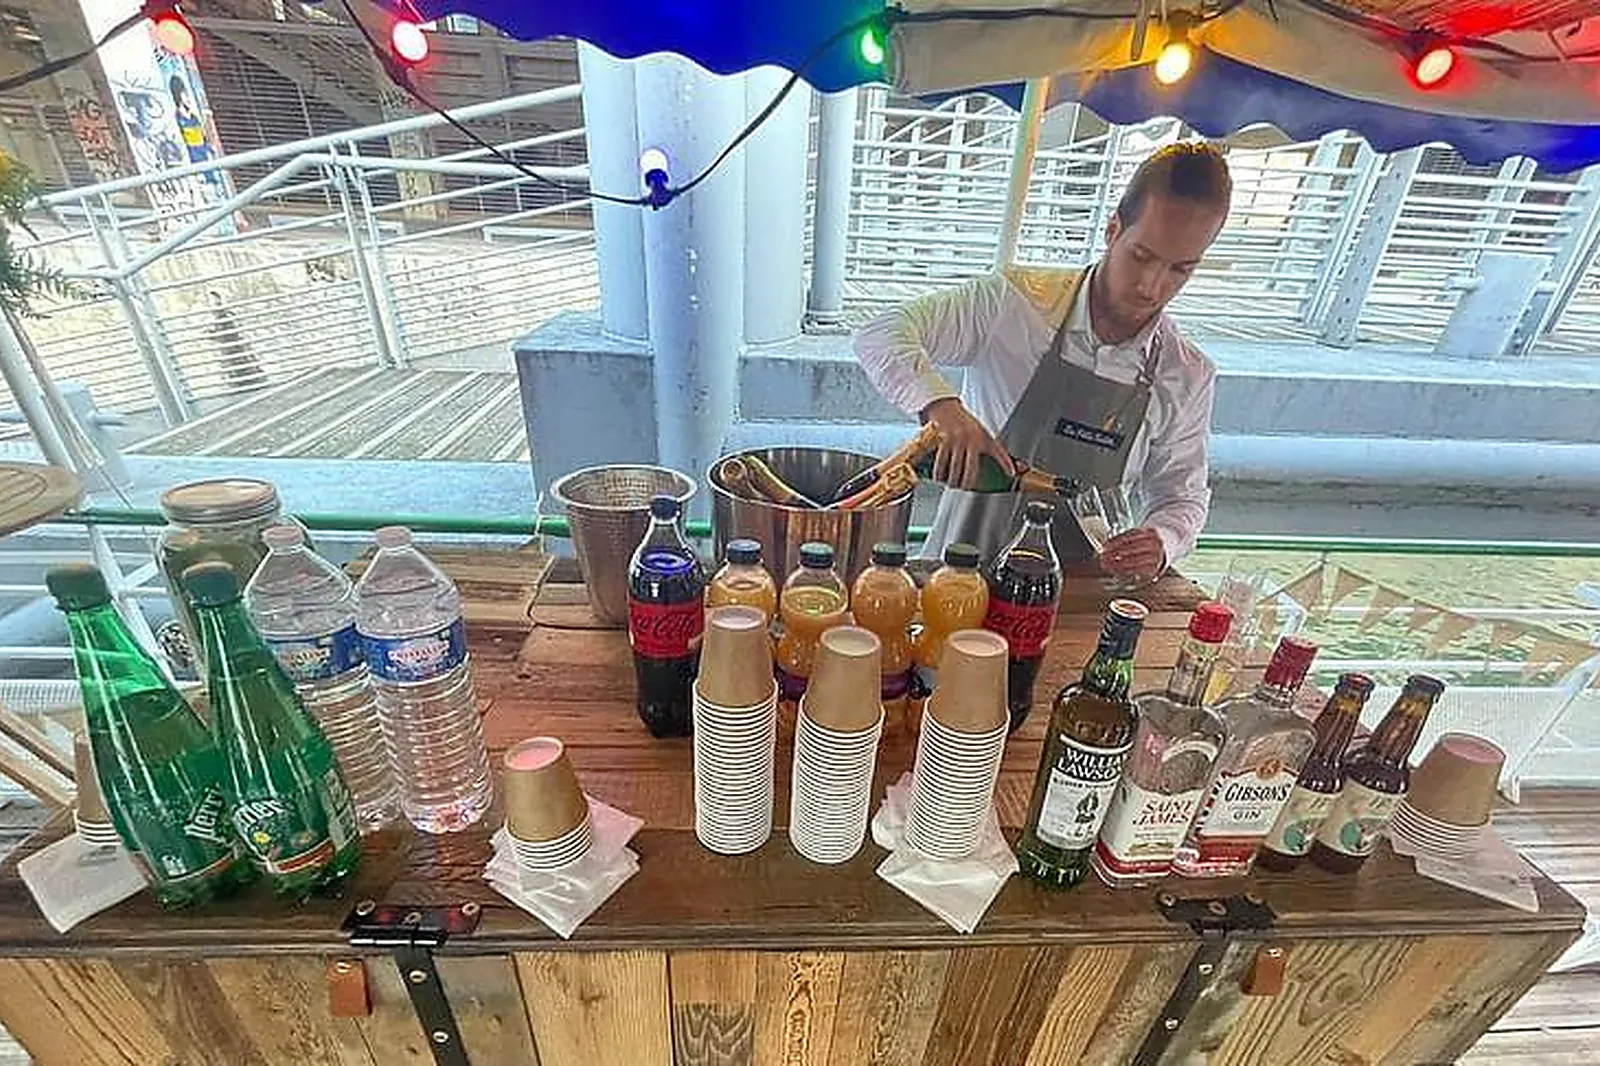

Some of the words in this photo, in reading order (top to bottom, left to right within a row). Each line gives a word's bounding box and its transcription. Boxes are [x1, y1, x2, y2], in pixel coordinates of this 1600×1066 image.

[1057, 757, 1122, 780] LAWSO
[1144, 797, 1194, 814] SAINT
[1132, 812, 1190, 827] JAMES
[1233, 810, 1263, 821] GIN
